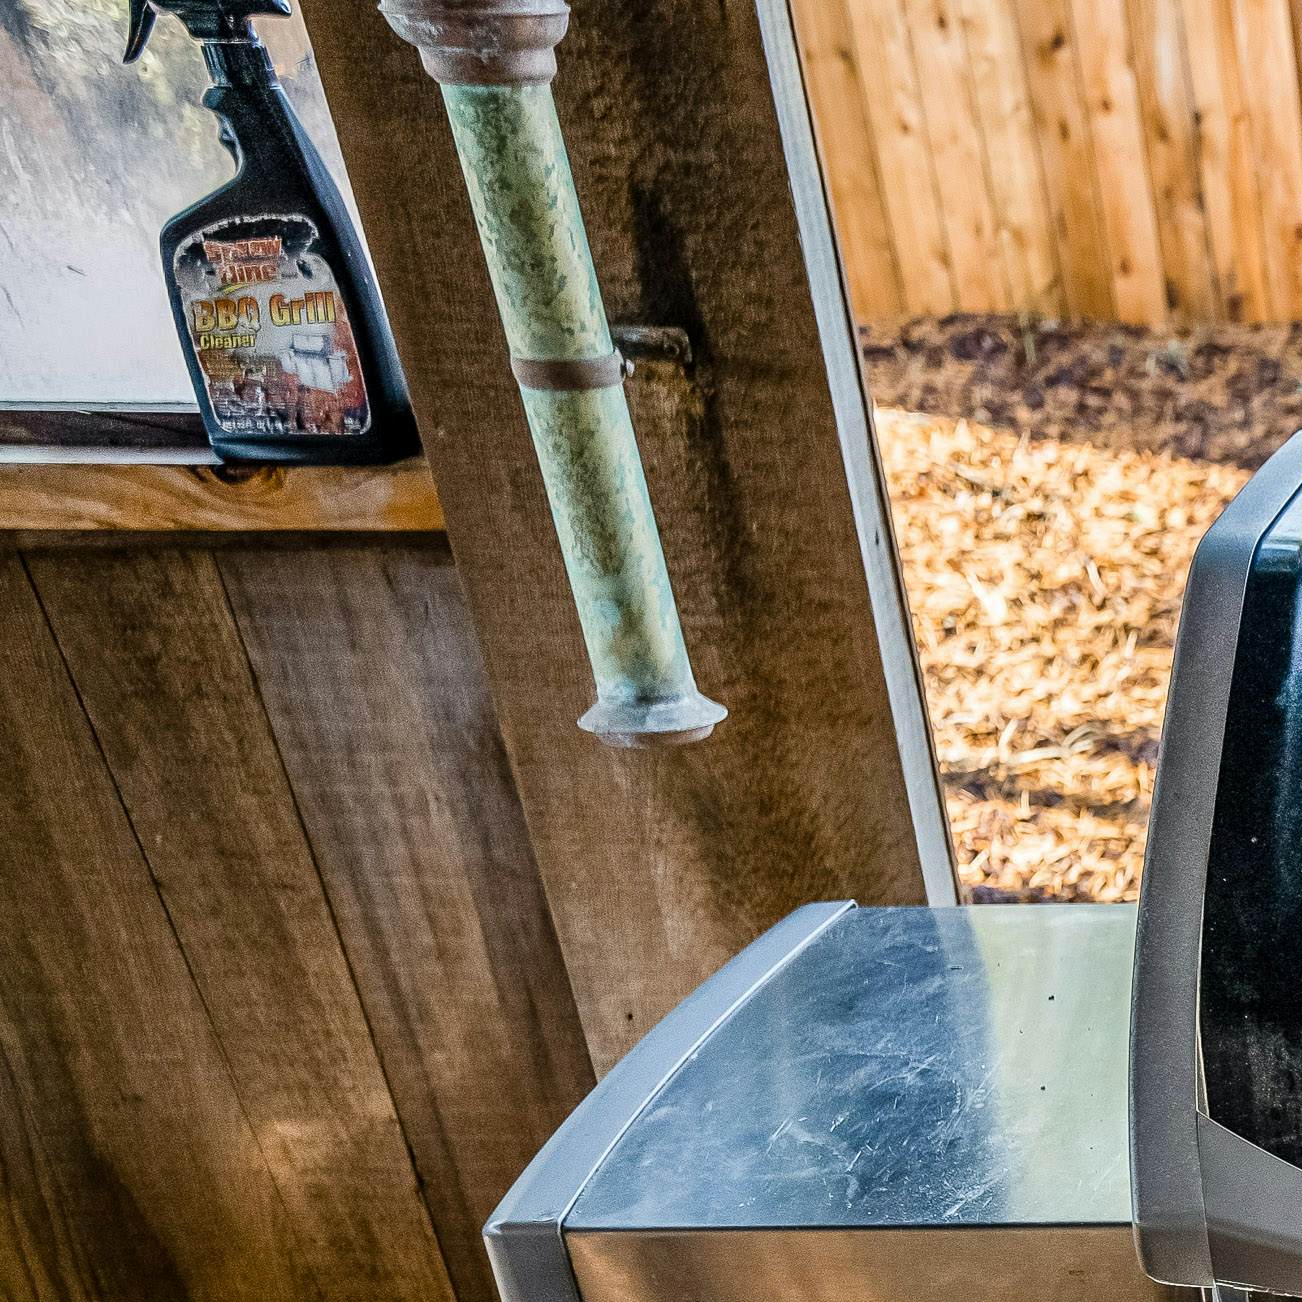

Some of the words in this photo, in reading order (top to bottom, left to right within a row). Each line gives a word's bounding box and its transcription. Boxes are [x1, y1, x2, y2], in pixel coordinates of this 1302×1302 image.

[192, 296, 261, 333] BBQ
[269, 291, 336, 327] Grill
[200, 333, 256, 350] Cleaner
